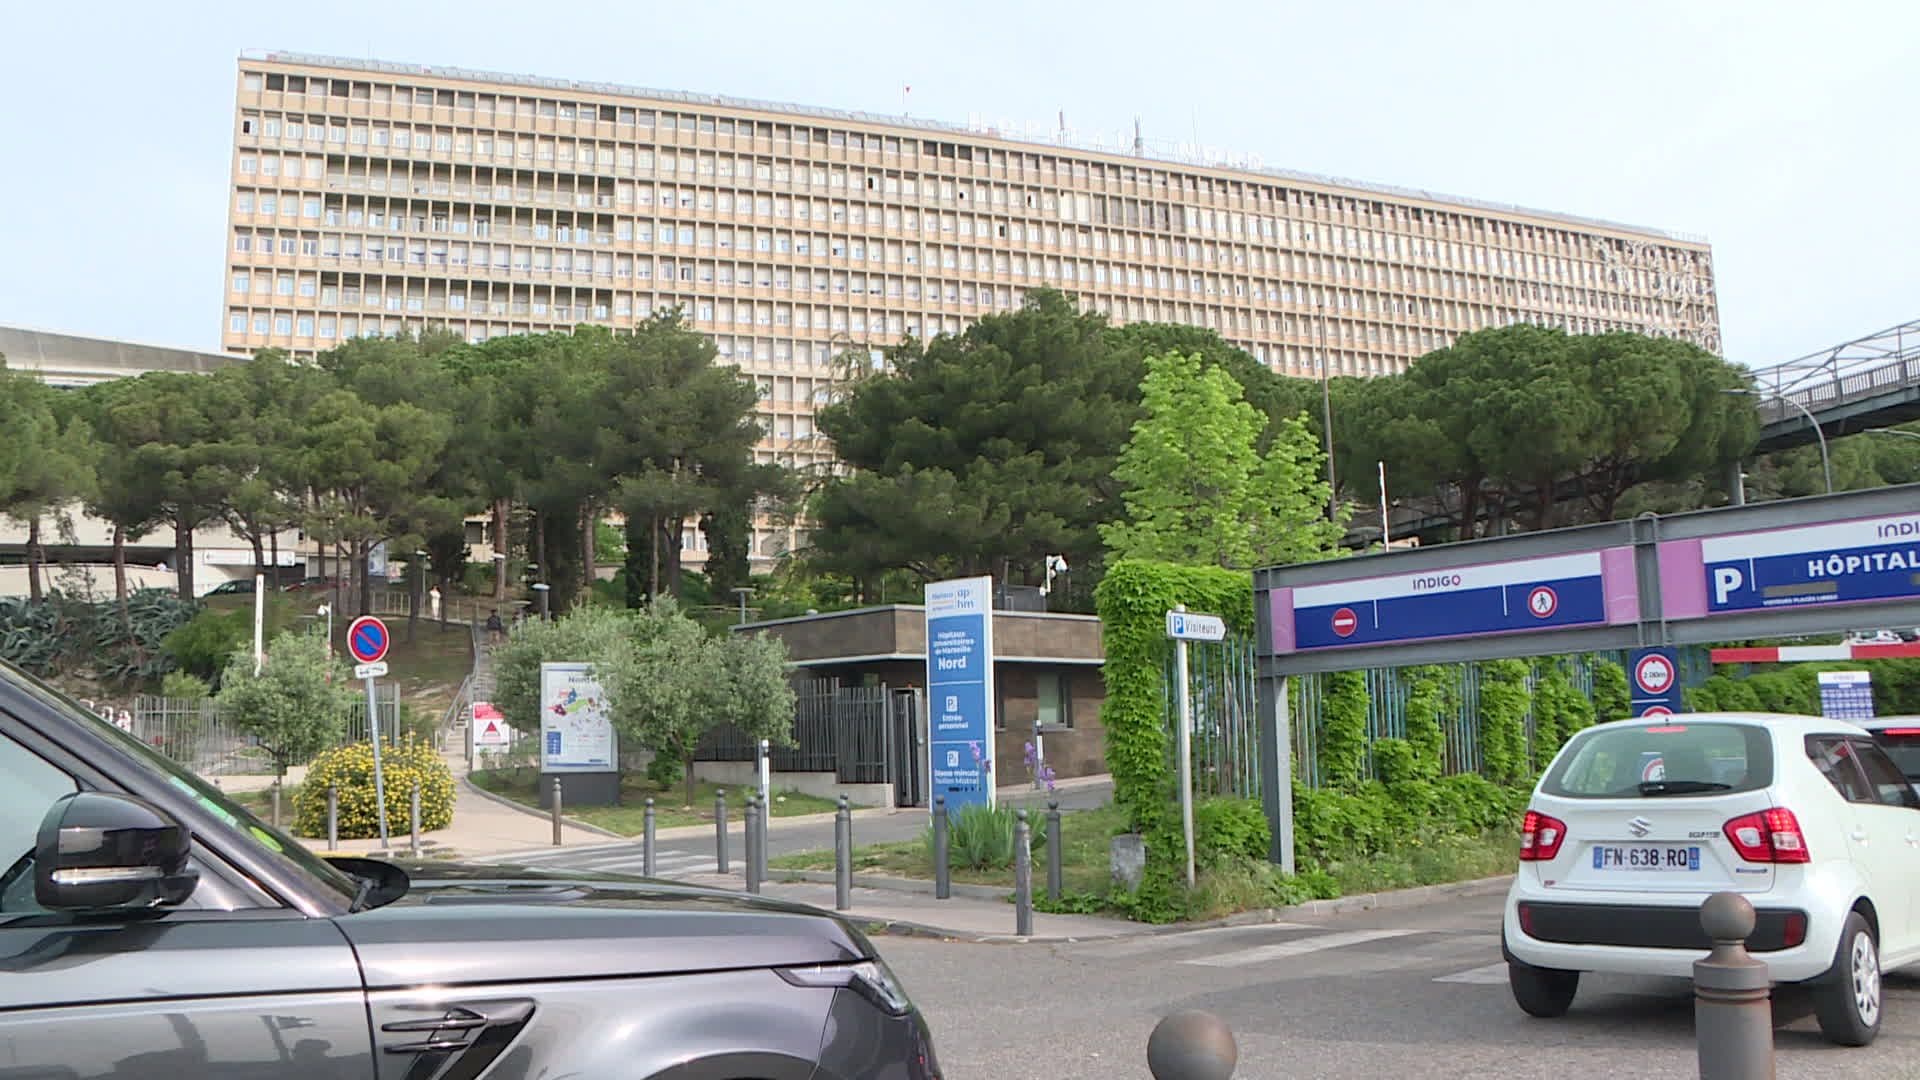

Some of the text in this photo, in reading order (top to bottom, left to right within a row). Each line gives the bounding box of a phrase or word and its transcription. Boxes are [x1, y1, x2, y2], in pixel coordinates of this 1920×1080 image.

[1807, 550, 1920, 578] HÔPITAL
[1412, 574, 1461, 590] INDIGO
[1713, 567, 1743, 604] P
[1186, 621, 1217, 634] Visiteurs
[942, 645, 972, 655] Marseille
[938, 656, 967, 671] Nord
[938, 721, 968, 731] personnel
